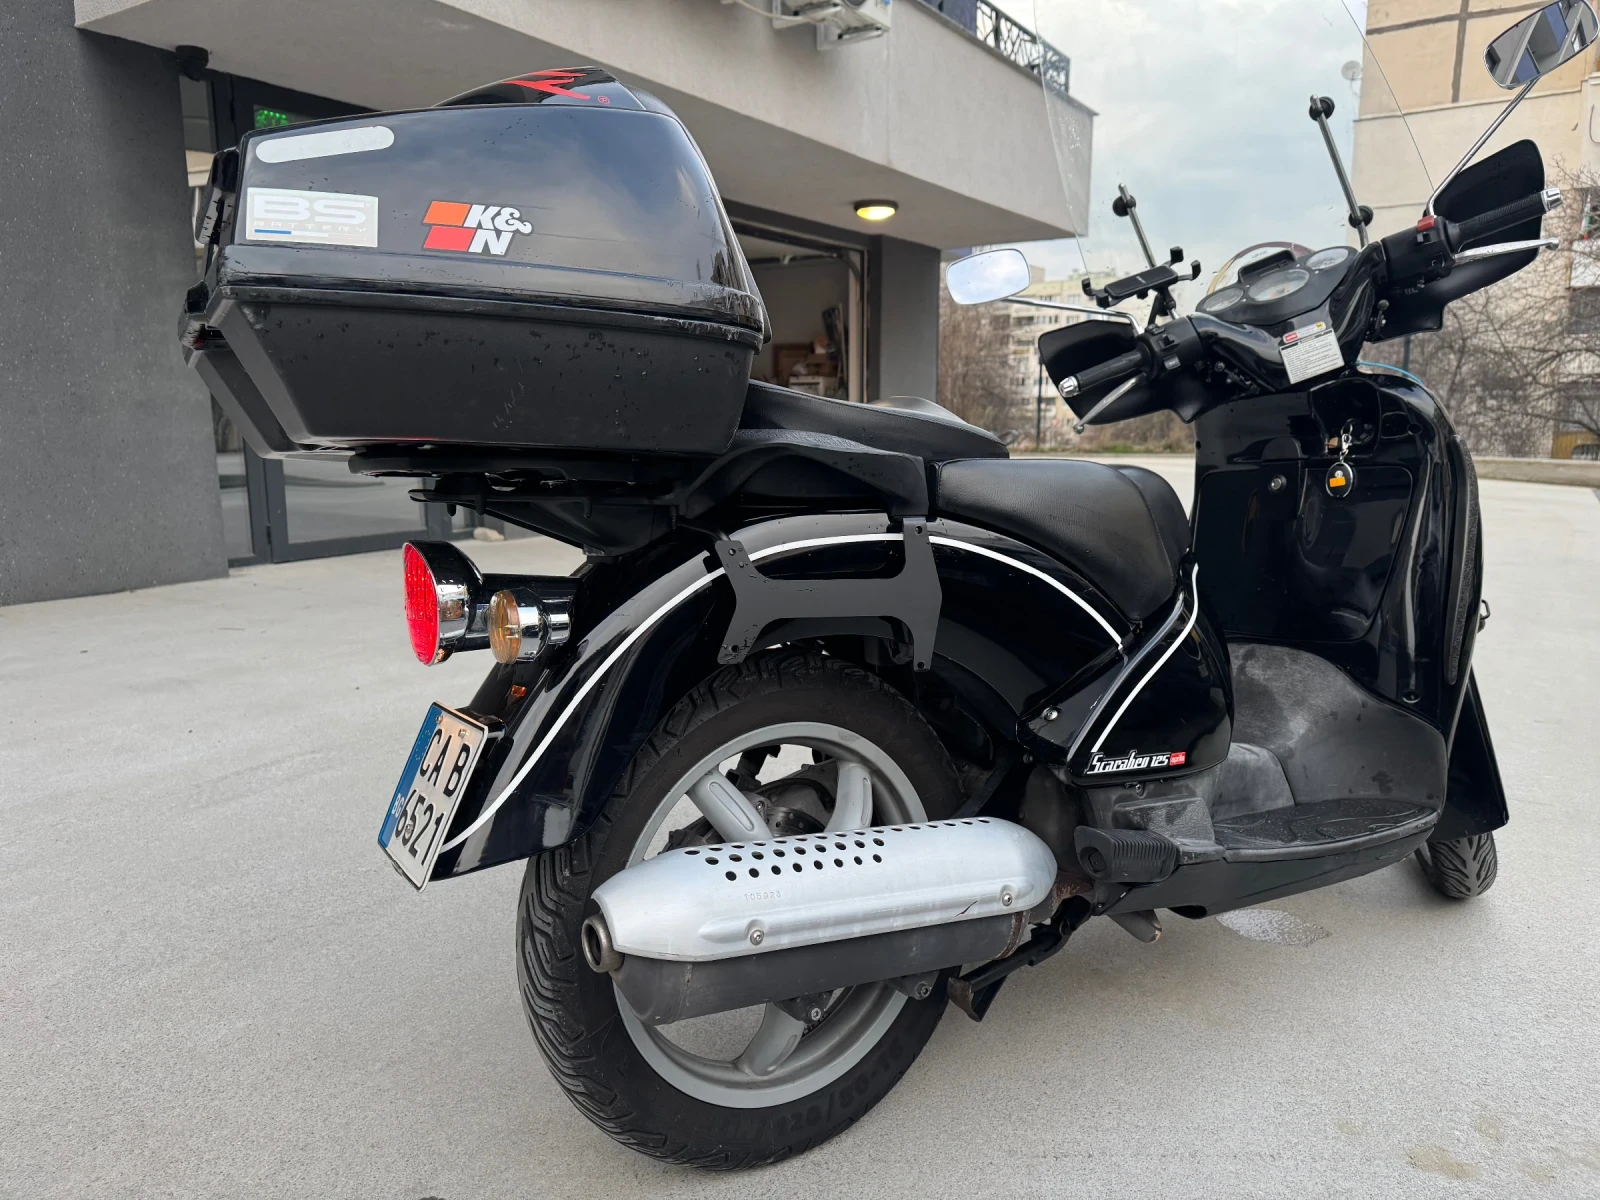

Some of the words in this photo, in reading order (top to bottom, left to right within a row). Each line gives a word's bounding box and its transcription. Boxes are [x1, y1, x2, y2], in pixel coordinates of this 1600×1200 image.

[254, 195, 366, 224] BS
[1087, 751, 1149, 774] Scarabeo
[1150, 755, 1170, 768] 125
[391, 793, 405, 818] BG
[395, 789, 445, 866] 6521
